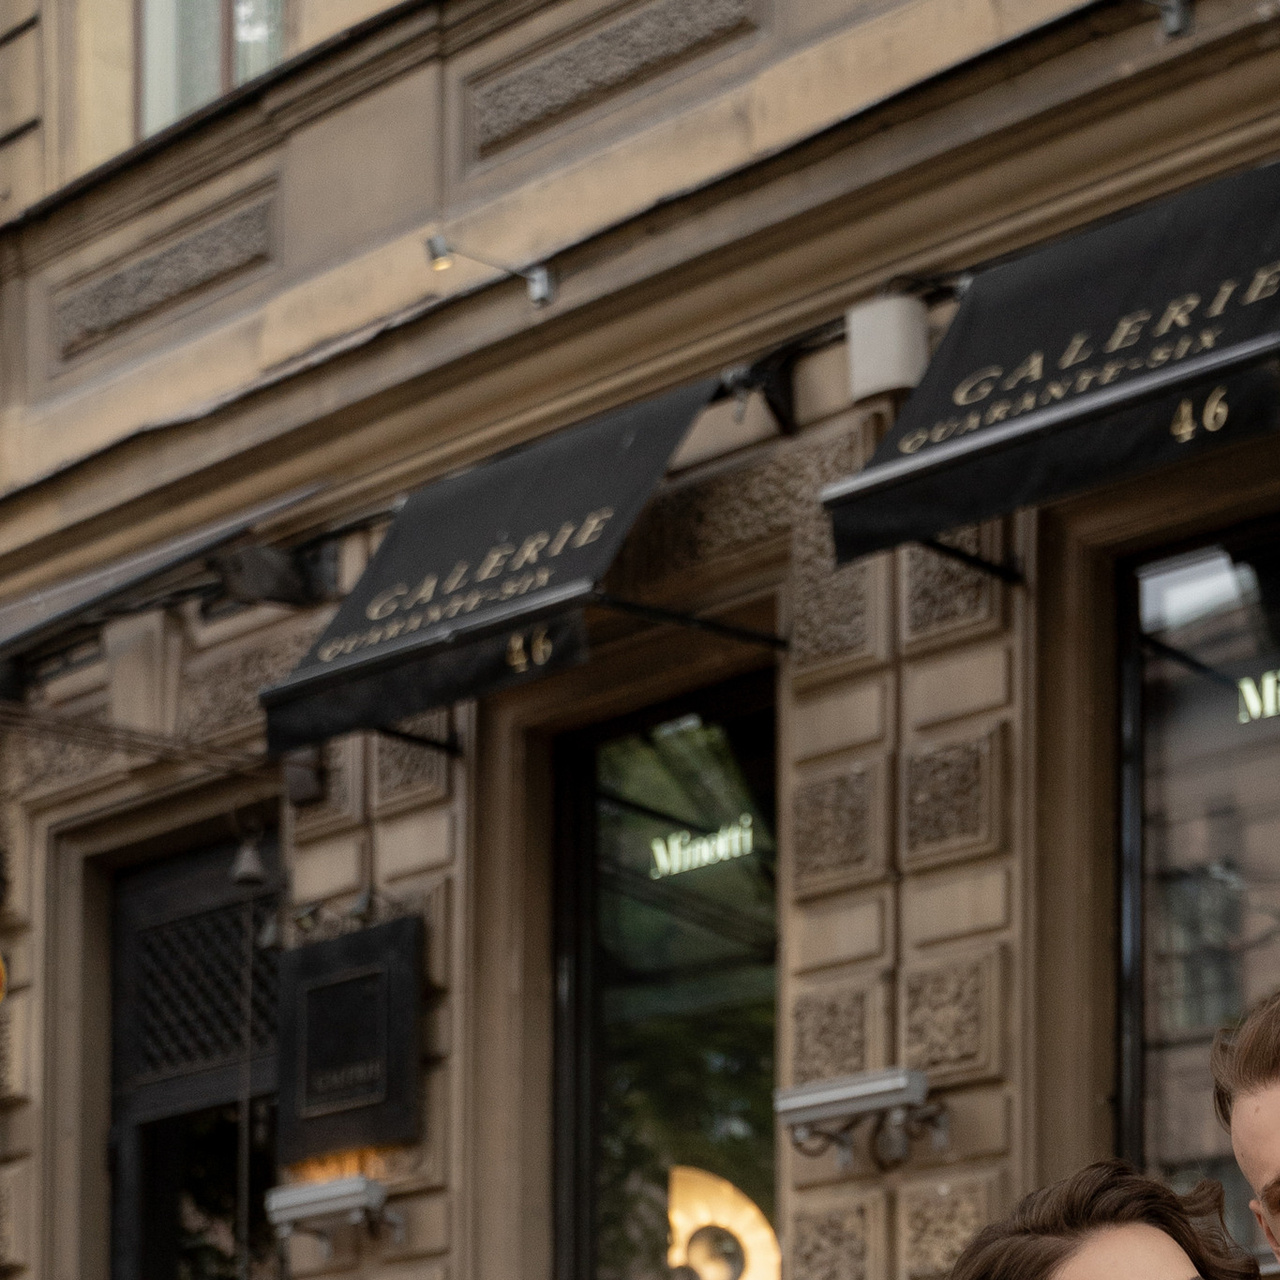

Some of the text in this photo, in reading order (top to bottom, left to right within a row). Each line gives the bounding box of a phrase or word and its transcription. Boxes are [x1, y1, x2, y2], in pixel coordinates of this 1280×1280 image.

[1170, 385, 1229, 444] 46
[365, 507, 614, 621] GALERIE
[506, 626, 553, 674] 46
